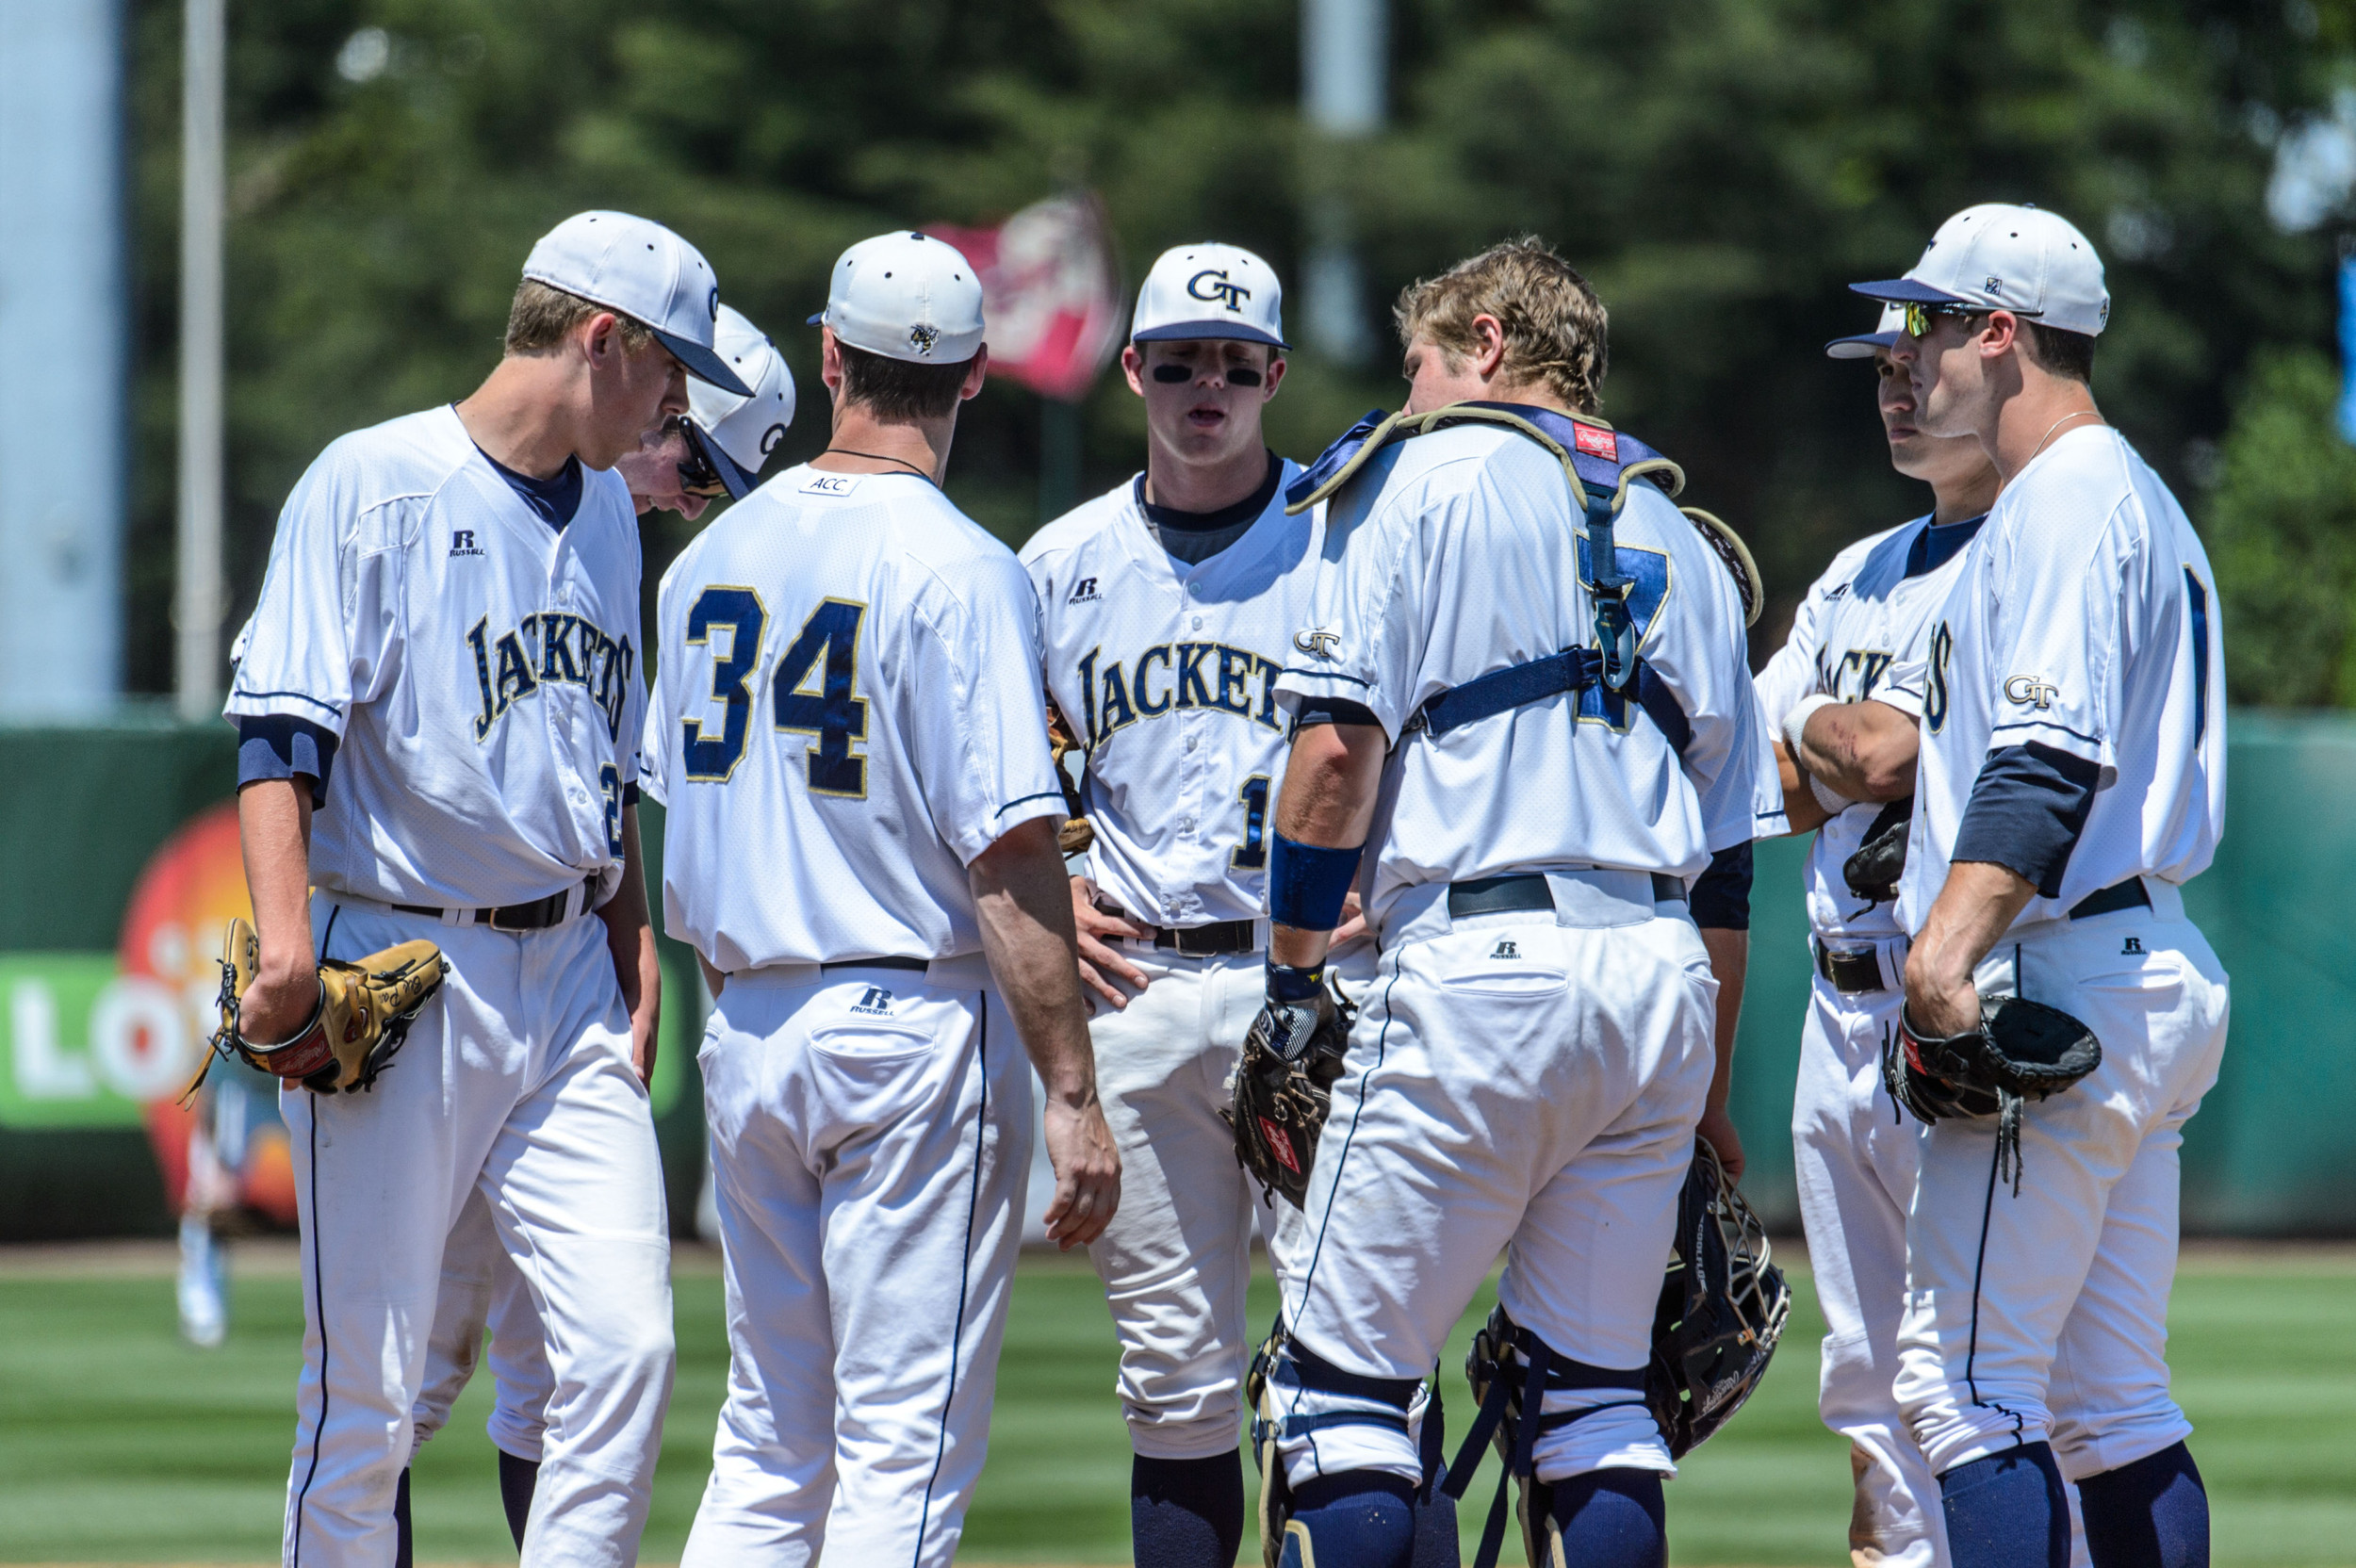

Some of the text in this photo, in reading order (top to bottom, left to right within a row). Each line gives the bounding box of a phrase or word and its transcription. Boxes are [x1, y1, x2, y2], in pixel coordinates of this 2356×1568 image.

[1186, 270, 1251, 313] GT
[810, 477, 848, 490] ACC
[450, 548, 485, 558] RUSSELL
[1573, 528, 1672, 733] 7
[465, 612, 634, 743] JACKETS
[681, 584, 870, 799] 34
[2004, 675, 2059, 710] GT
[1078, 642, 1297, 767] JACKET
[849, 1005, 894, 1016] RUSSELL
